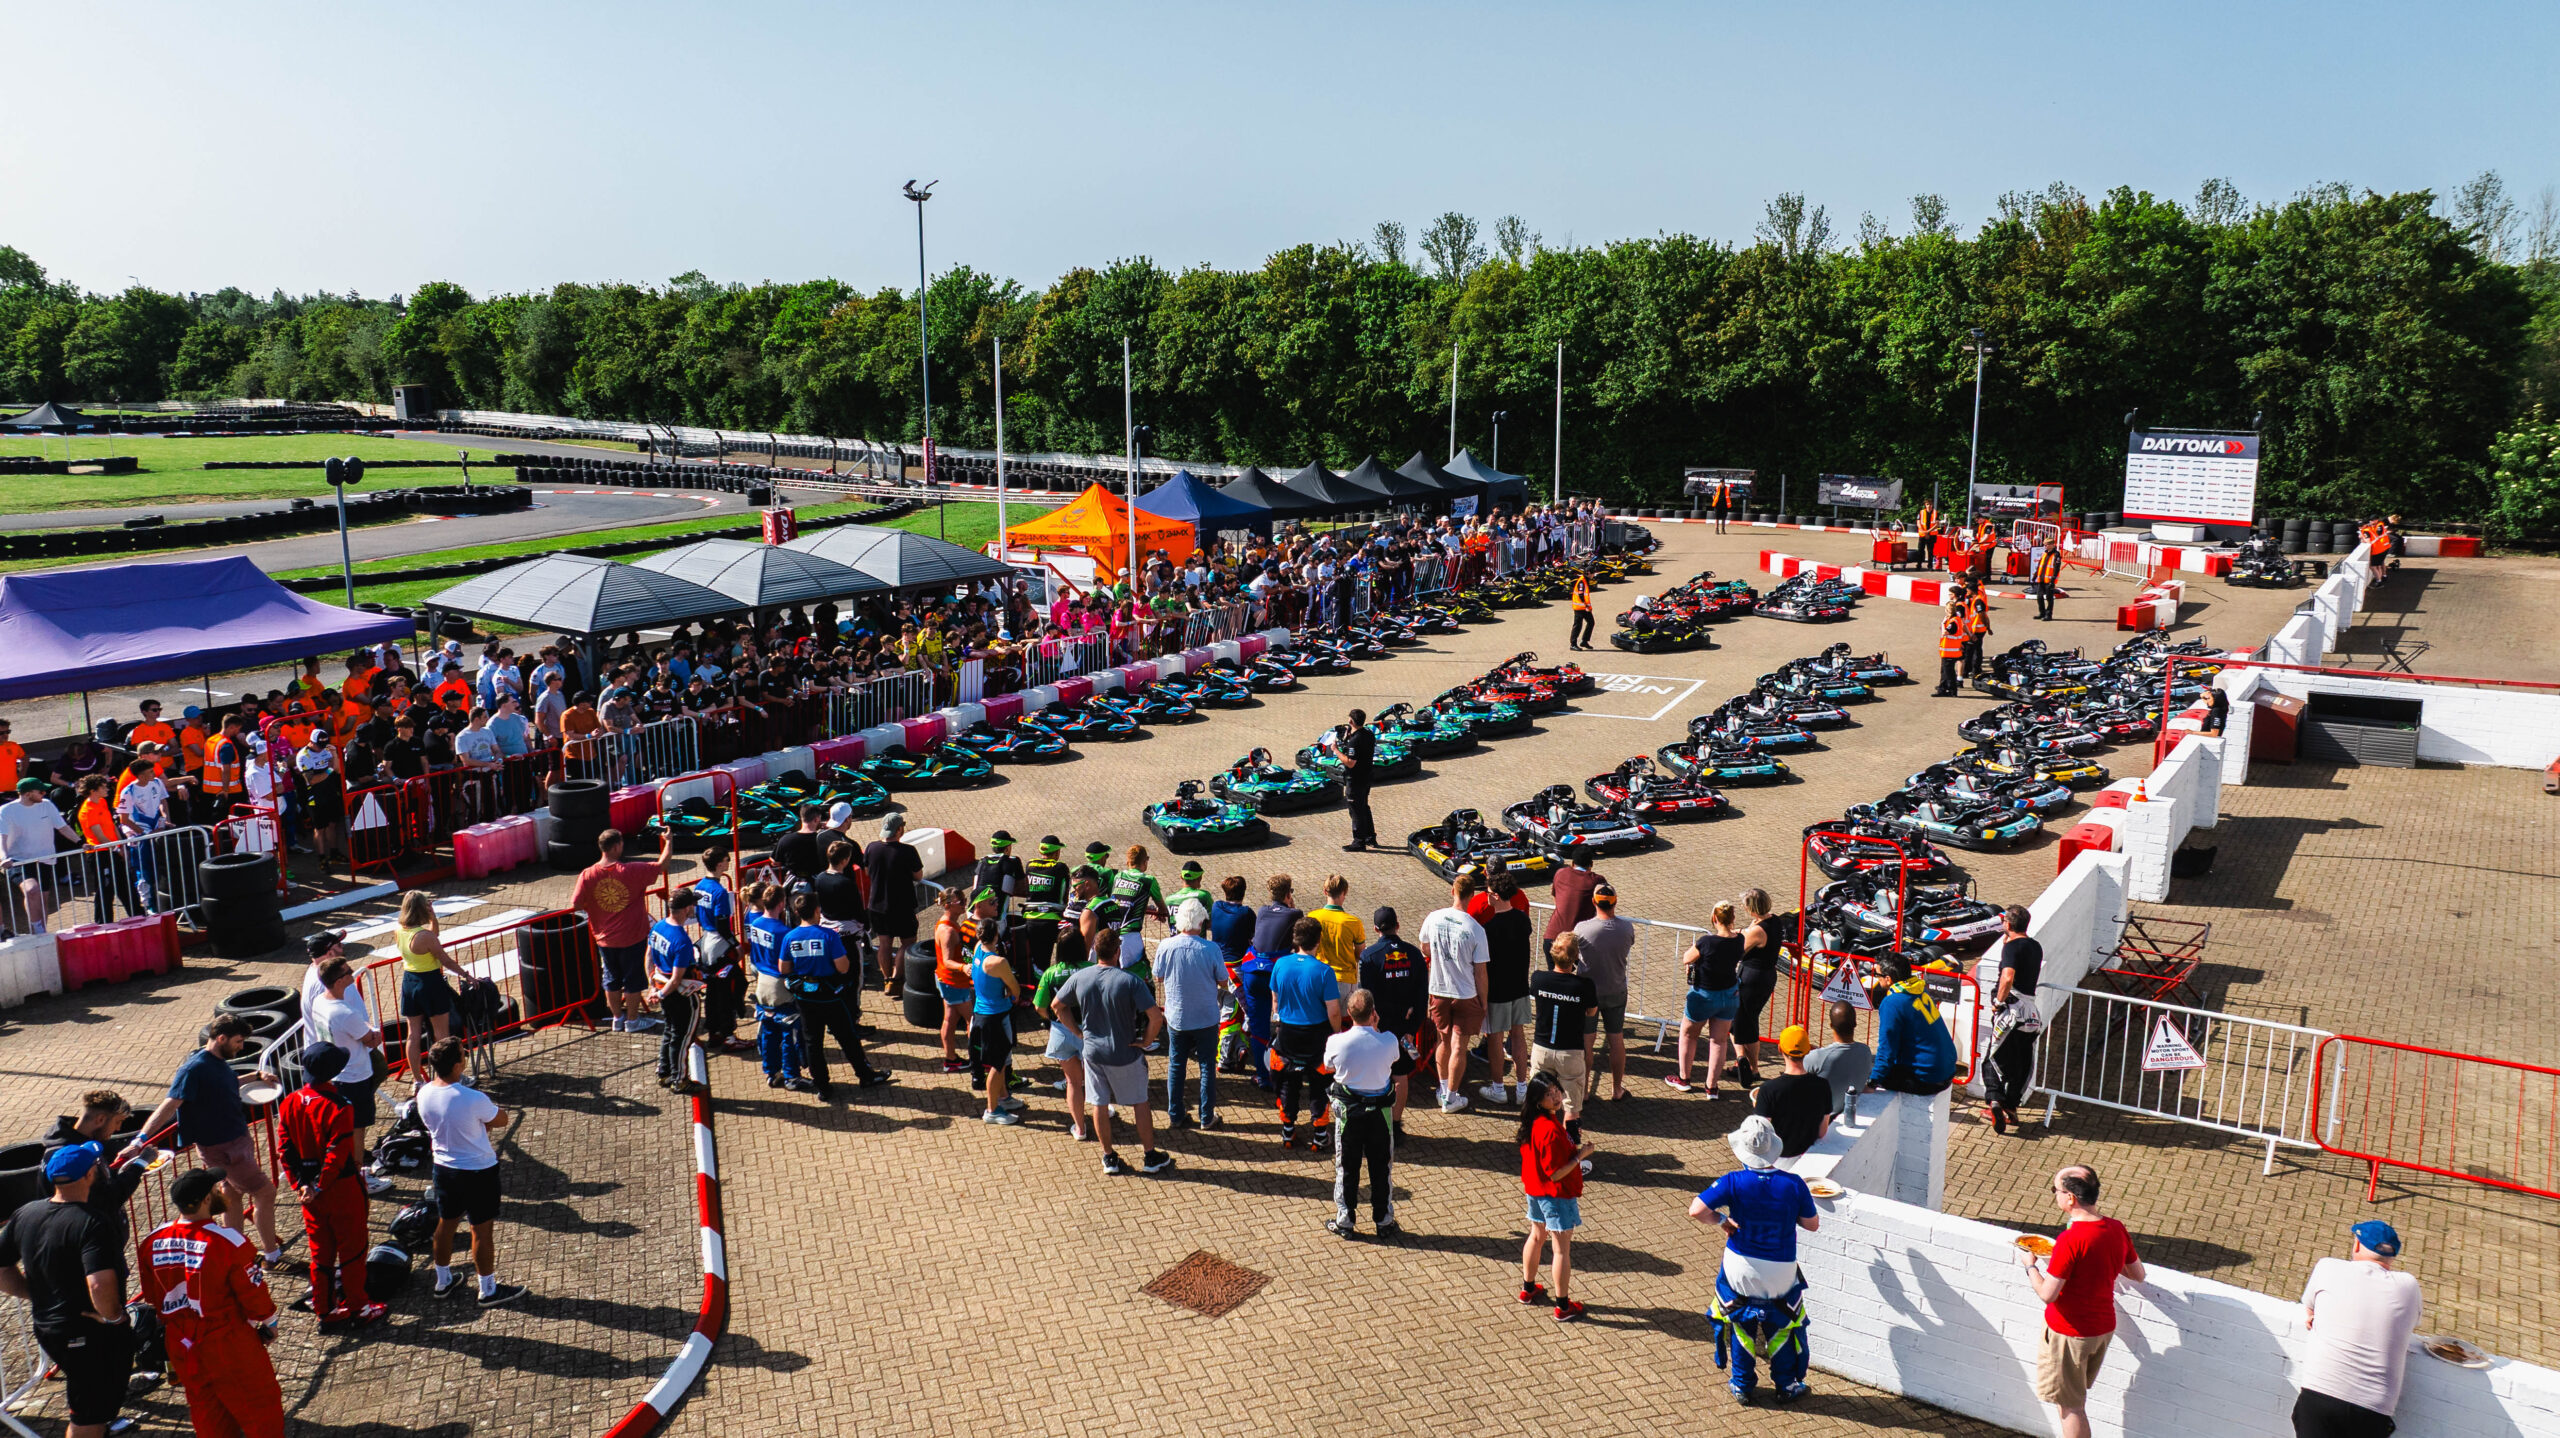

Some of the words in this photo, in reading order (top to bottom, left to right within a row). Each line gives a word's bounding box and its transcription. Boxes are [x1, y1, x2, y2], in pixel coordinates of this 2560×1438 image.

[2141, 437, 2225, 454] DAYTONA
[1840, 482, 1859, 499] 24
[1018, 533, 1049, 542] 24MX
[1166, 529, 1189, 538] 24MX
[1069, 535, 1102, 544] 24MX
[1601, 683, 1677, 695] BIN
[1827, 986, 1865, 998] PROHIBITED
[1936, 985, 1954, 993] ONLY
[1537, 988, 1581, 1003] PETRONAS
[1836, 993, 1853, 1001] AREA
[1549, 1004, 1559, 1044] 1
[2150, 1055, 2195, 1063] DANGEROUS
